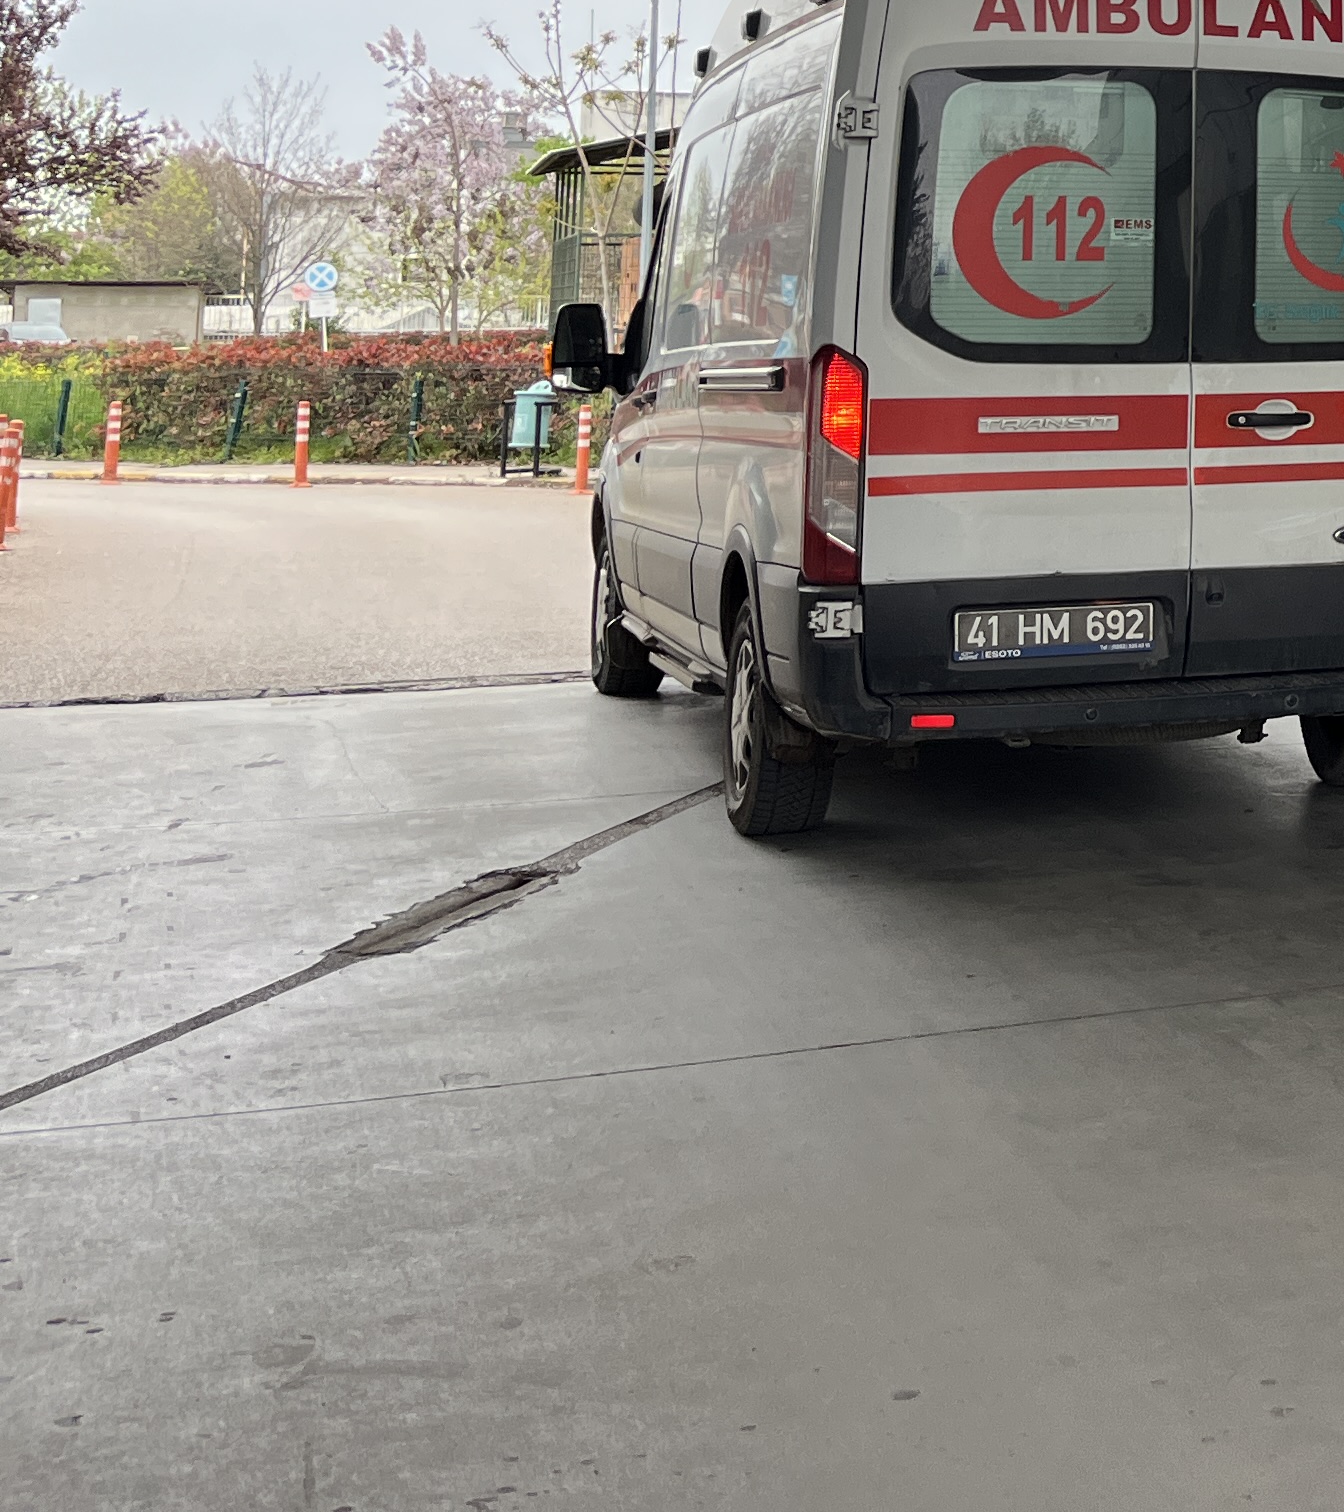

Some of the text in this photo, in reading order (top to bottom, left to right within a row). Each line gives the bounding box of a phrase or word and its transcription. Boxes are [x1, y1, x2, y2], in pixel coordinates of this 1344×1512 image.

[1012, 195, 1106, 262] 112
[1125, 219, 1152, 229] EMS
[967, 609, 1144, 648] 41 HM 692
[985, 649, 1021, 659] ESOTO
